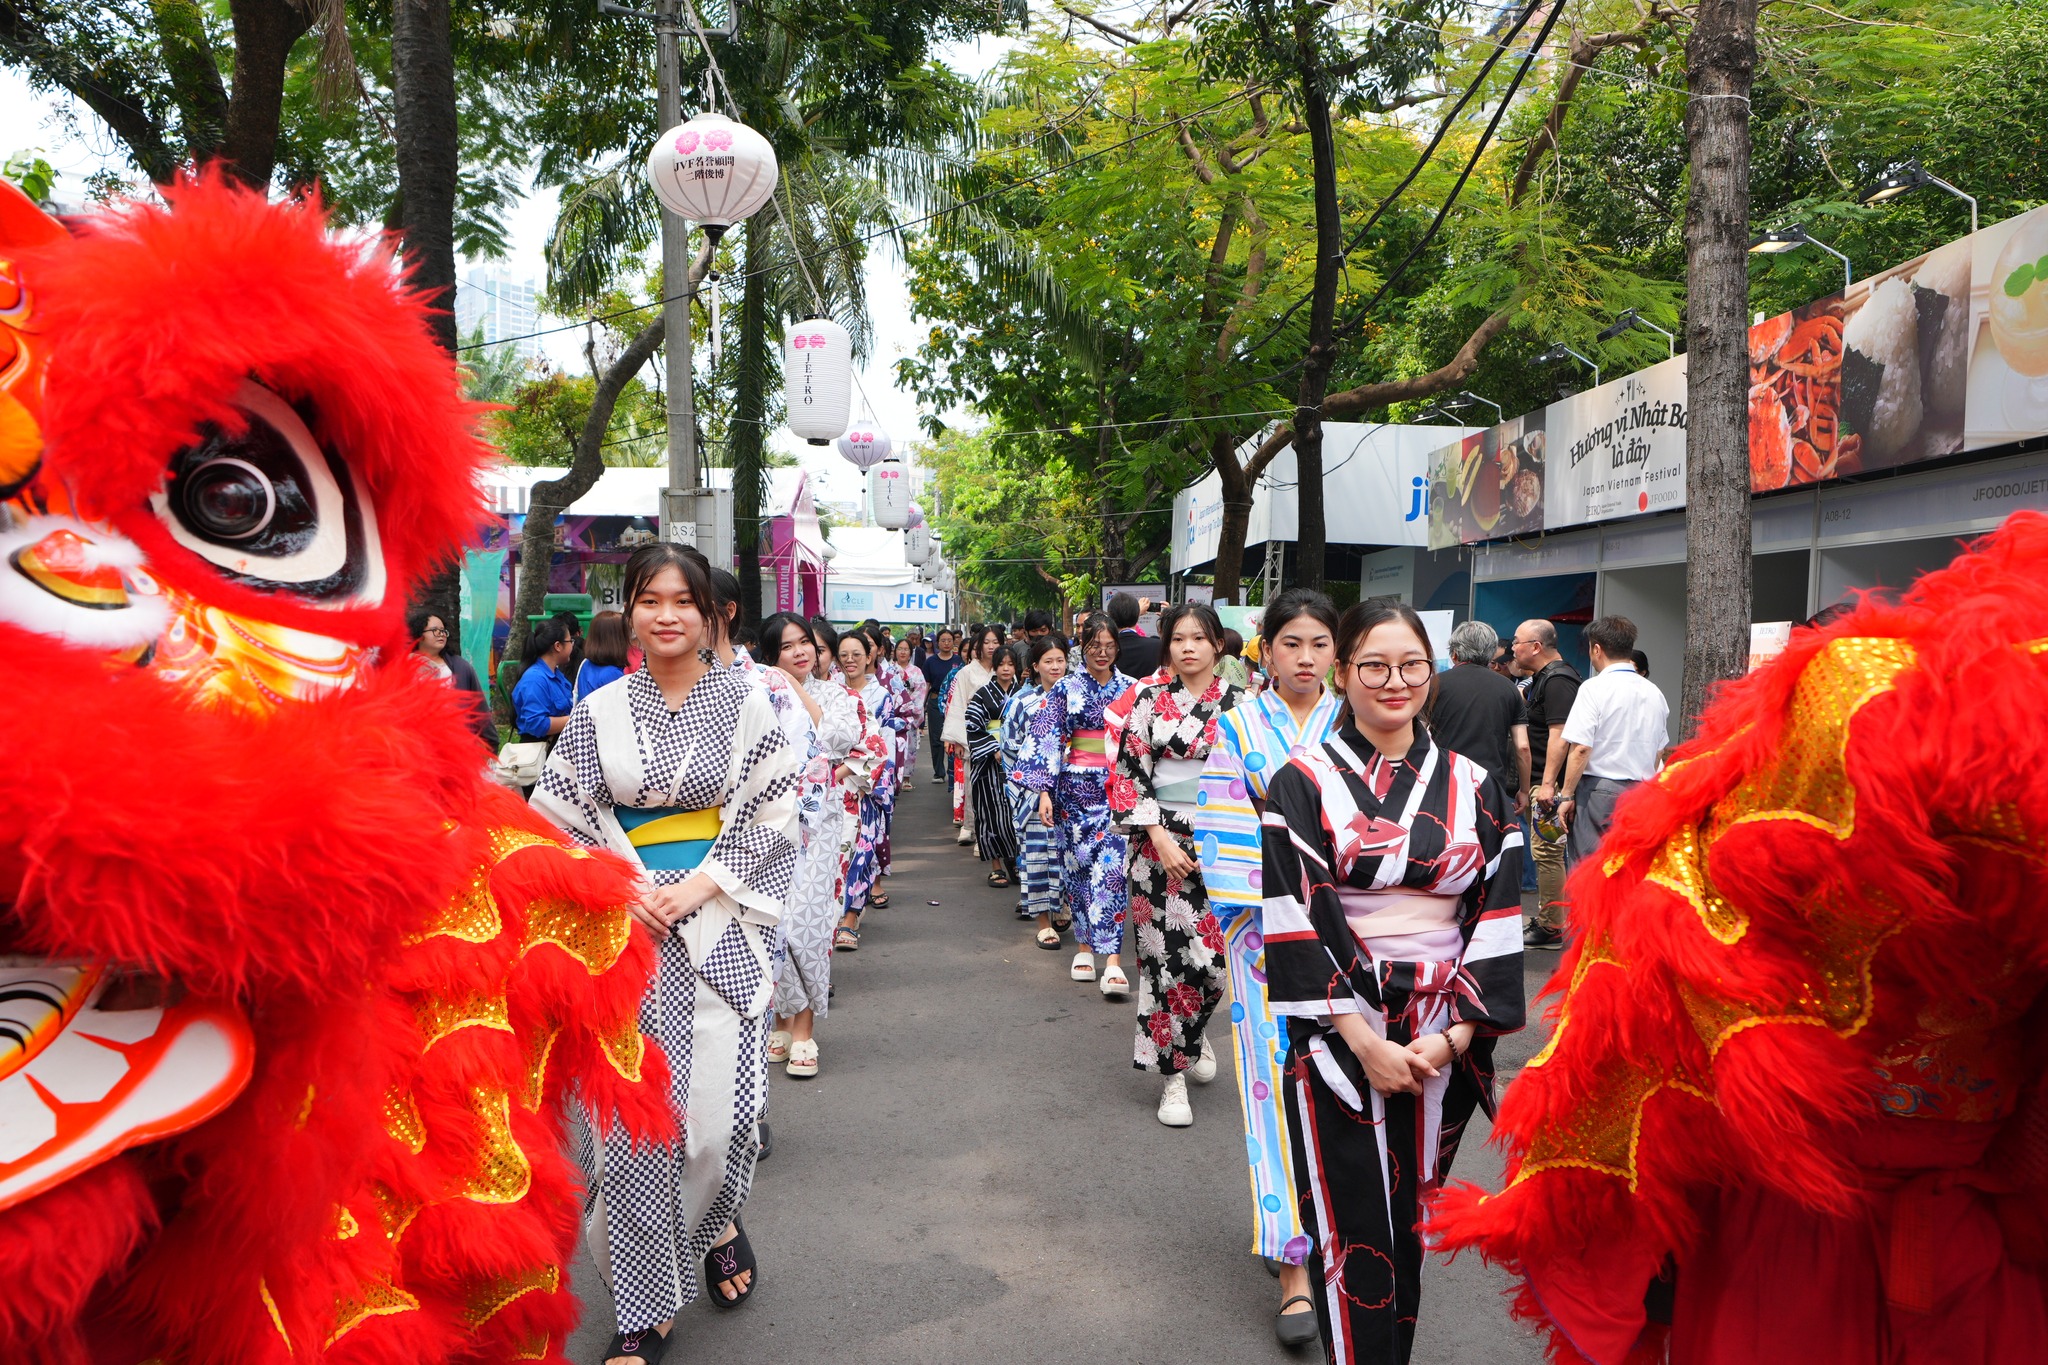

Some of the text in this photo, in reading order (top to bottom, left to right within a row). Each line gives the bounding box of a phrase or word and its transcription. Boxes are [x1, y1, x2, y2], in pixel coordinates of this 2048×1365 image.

[685, 169, 725, 182] 二階俊博
[804, 352, 813, 406] JETRO
[1569, 421, 1613, 469] Hương
[1614, 407, 1628, 440] vị
[1629, 400, 1669, 434] Nhật
[1612, 436, 1651, 470] là đây
[1582, 463, 1681, 498] Japan Vietnam Festival
[1972, 479, 2048, 502] JFOODO/JET
[1649, 490, 1678, 505] JFOODO
[1585, 505, 1601, 519] JETRO
[1824, 508, 1851, 523] A08-12
[781, 564, 790, 605] PAVILION
[894, 593, 939, 610] JFIC
